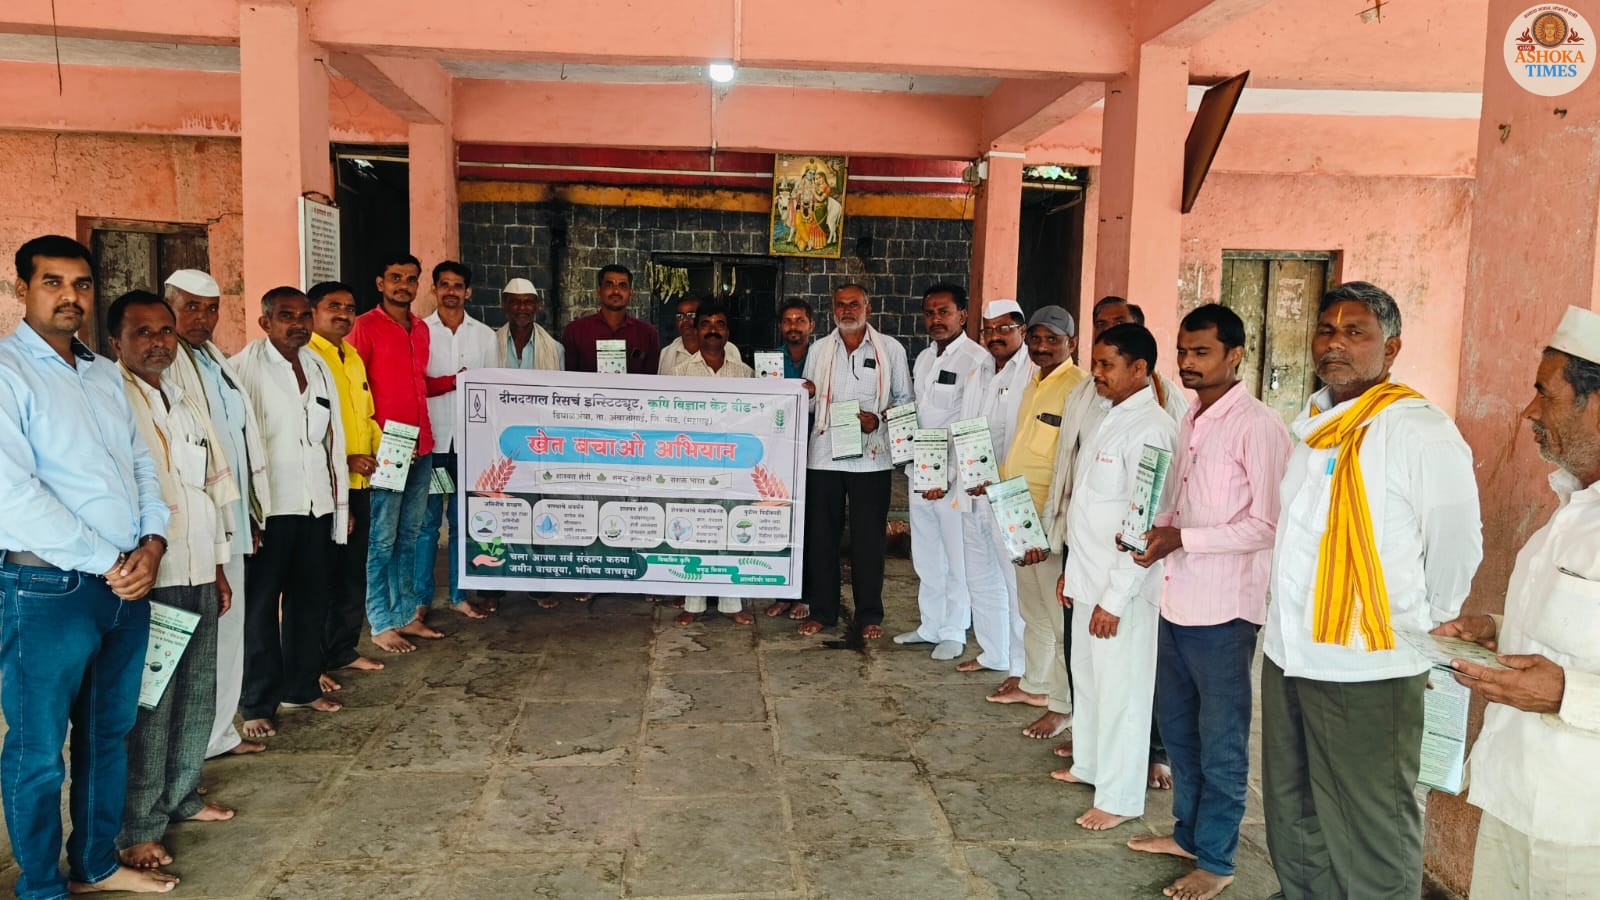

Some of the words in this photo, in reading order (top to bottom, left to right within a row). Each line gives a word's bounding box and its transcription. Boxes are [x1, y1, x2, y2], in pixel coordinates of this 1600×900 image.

[499, 390, 548, 406] दीनदयाल
[552, 392, 580, 407] रिसर्च
[648, 396, 669, 413] कृषि
[673, 397, 706, 411] विज्ञान
[526, 429, 566, 455] खेत
[573, 432, 645, 457] बचाओ
[655, 433, 737, 461] अभियान
[509, 553, 528, 561] चला
[532, 553, 556, 561] आपण
[560, 552, 573, 562] सर्व
[576, 553, 602, 563] संकल्प
[509, 563, 532, 573] जमीन
[576, 565, 601, 574] भविष्य
